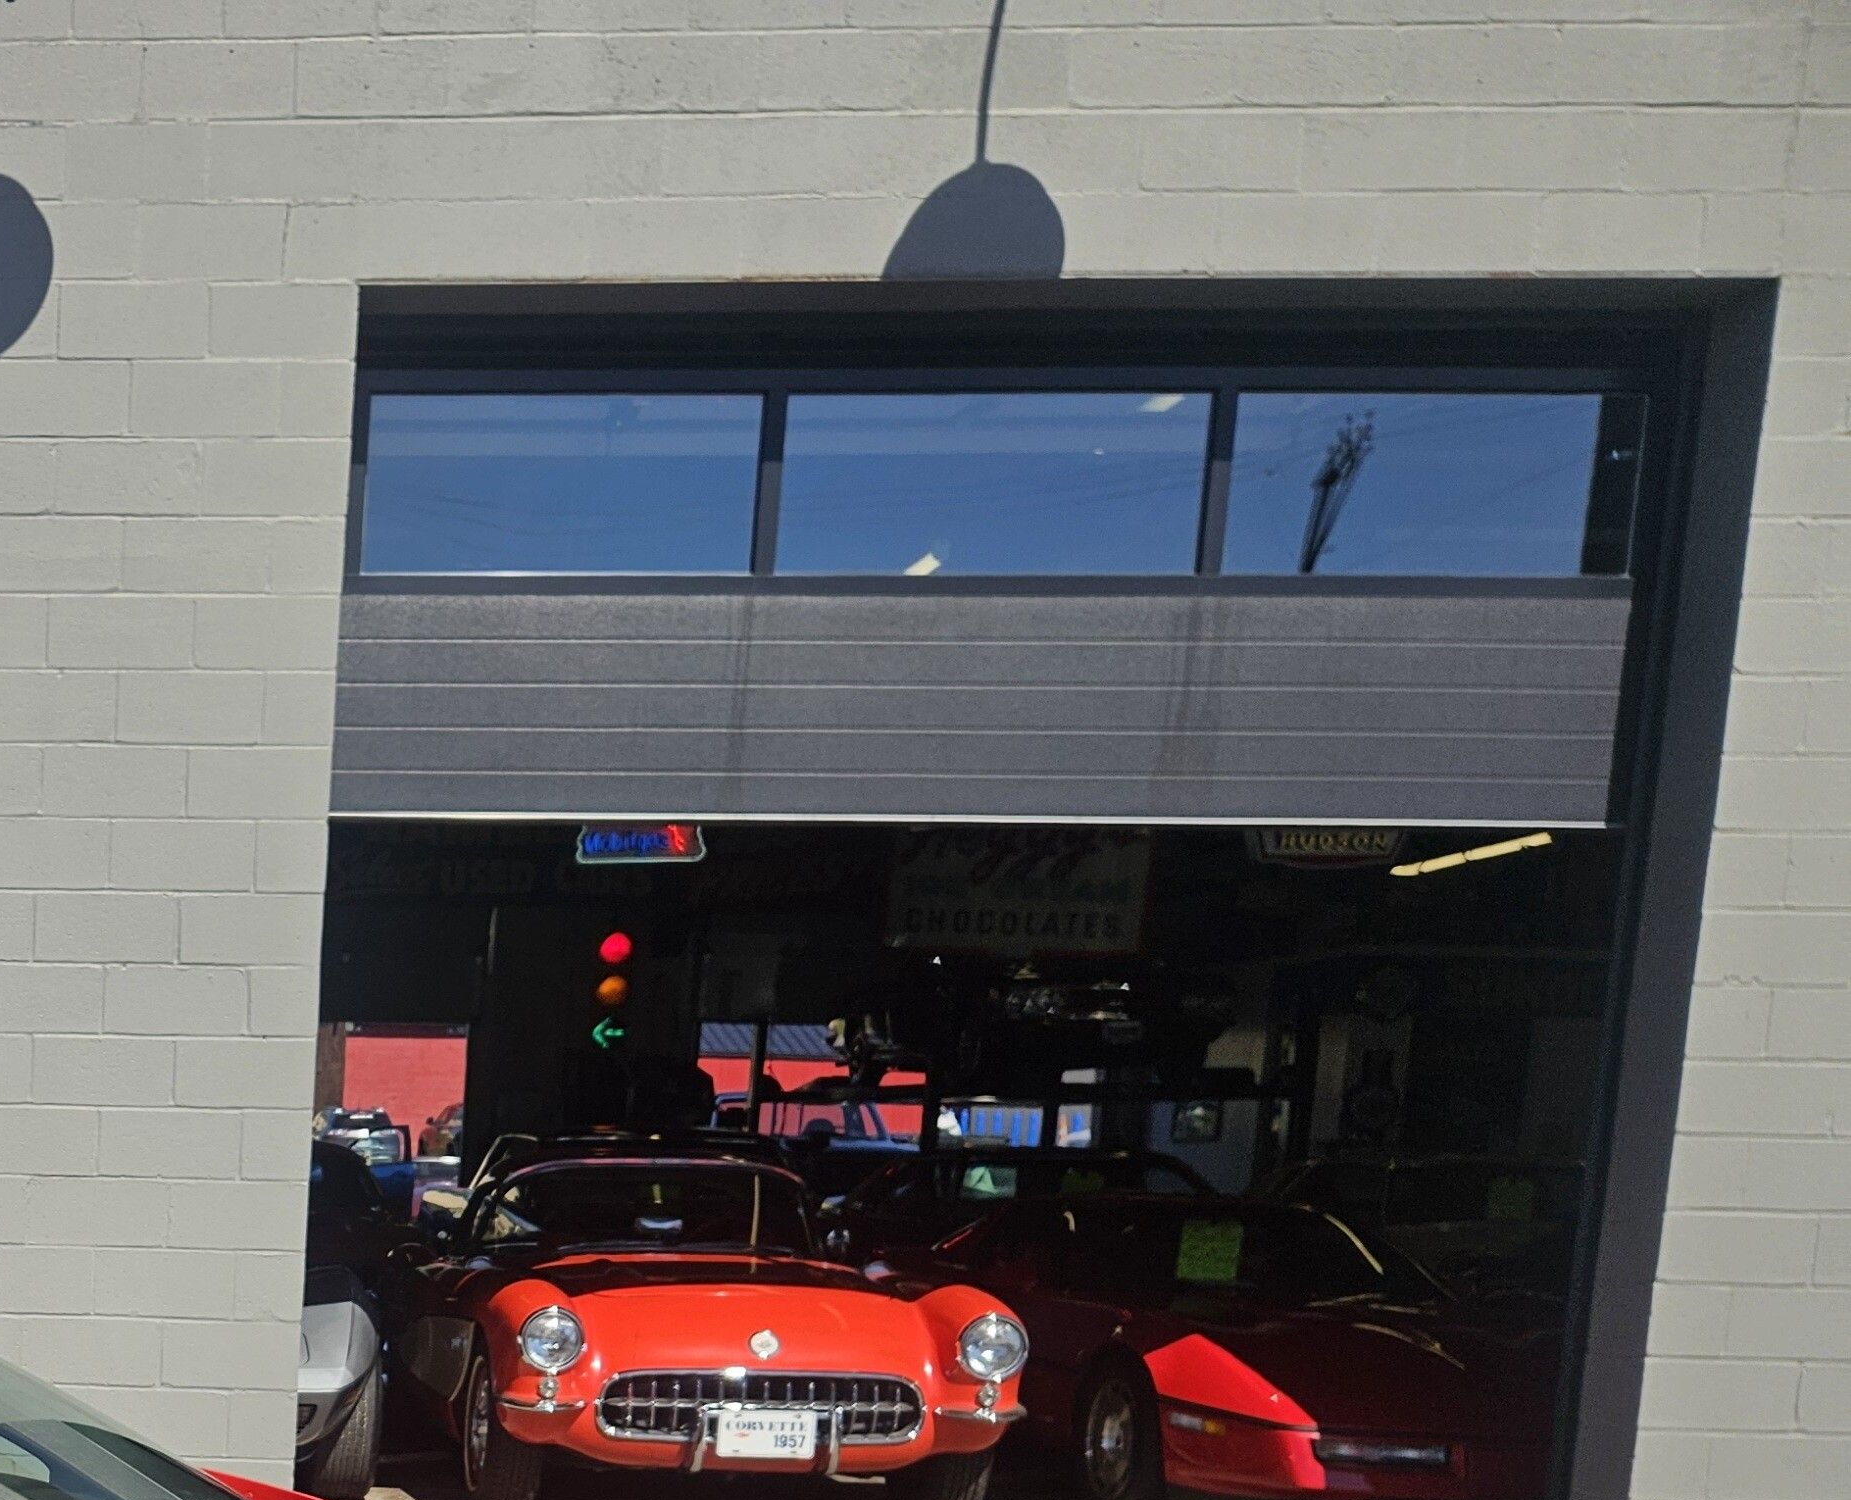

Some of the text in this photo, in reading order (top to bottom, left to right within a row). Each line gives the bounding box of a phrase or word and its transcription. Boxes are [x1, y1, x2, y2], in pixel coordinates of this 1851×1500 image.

[905, 907, 1120, 939] CHOCOLATES
[725, 1420, 806, 1431] CORVETTE
[773, 1434, 806, 1448] 1957
